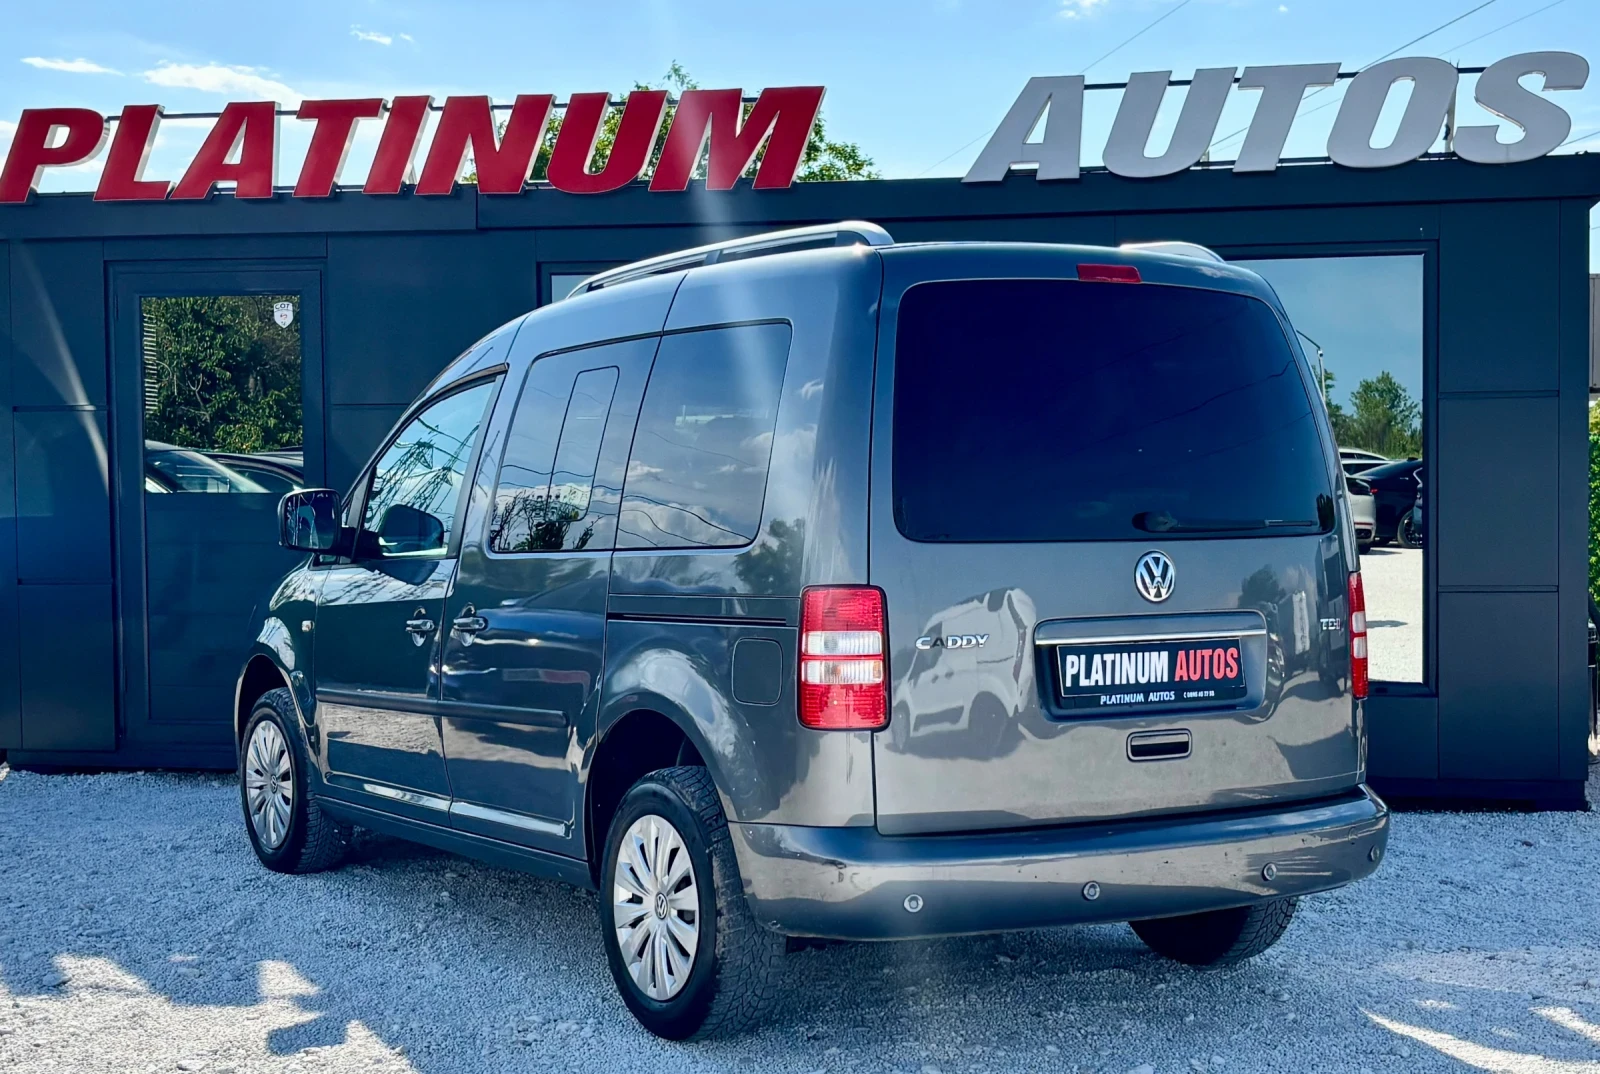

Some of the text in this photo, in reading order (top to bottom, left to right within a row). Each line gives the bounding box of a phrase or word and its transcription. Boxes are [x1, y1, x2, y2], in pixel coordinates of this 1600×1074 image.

[0, 51, 1589, 204] PLATINUM AUTOS
[915, 634, 989, 650] CADDY
[1065, 648, 1239, 687] PLATINUM AUTOS
[1100, 694, 1144, 705] PLATINUM
[1148, 691, 1175, 701] AUTOS
